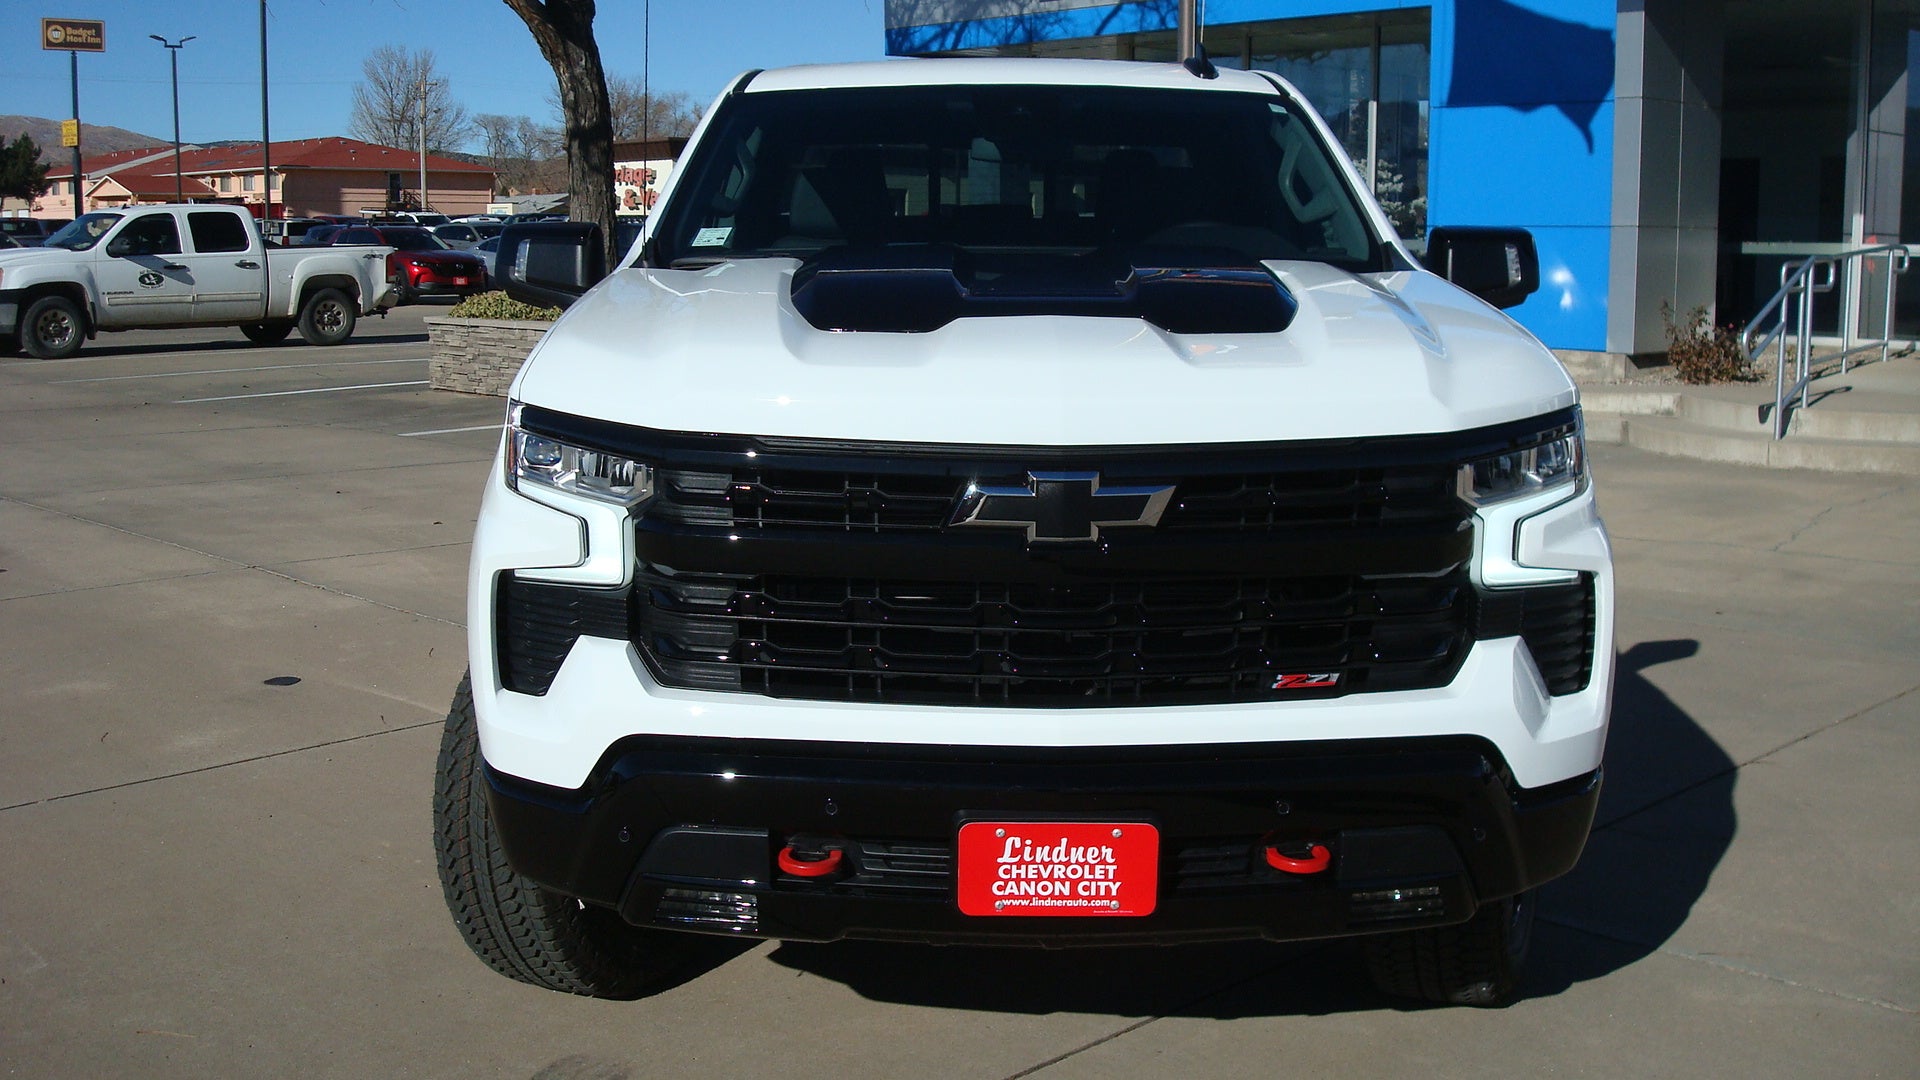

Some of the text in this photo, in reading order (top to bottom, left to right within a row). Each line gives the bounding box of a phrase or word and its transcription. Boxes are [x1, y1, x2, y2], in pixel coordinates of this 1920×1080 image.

[66, 27, 95, 36] Budget
[66, 35, 101, 44] Host Inn
[1272, 672, 1340, 689] Z71
[997, 836, 1116, 864] Lindner
[998, 864, 1117, 880] CHEVROLET
[991, 880, 1122, 896] CANON CITY
[1002, 897, 1111, 908] www.lindnerauto.com
